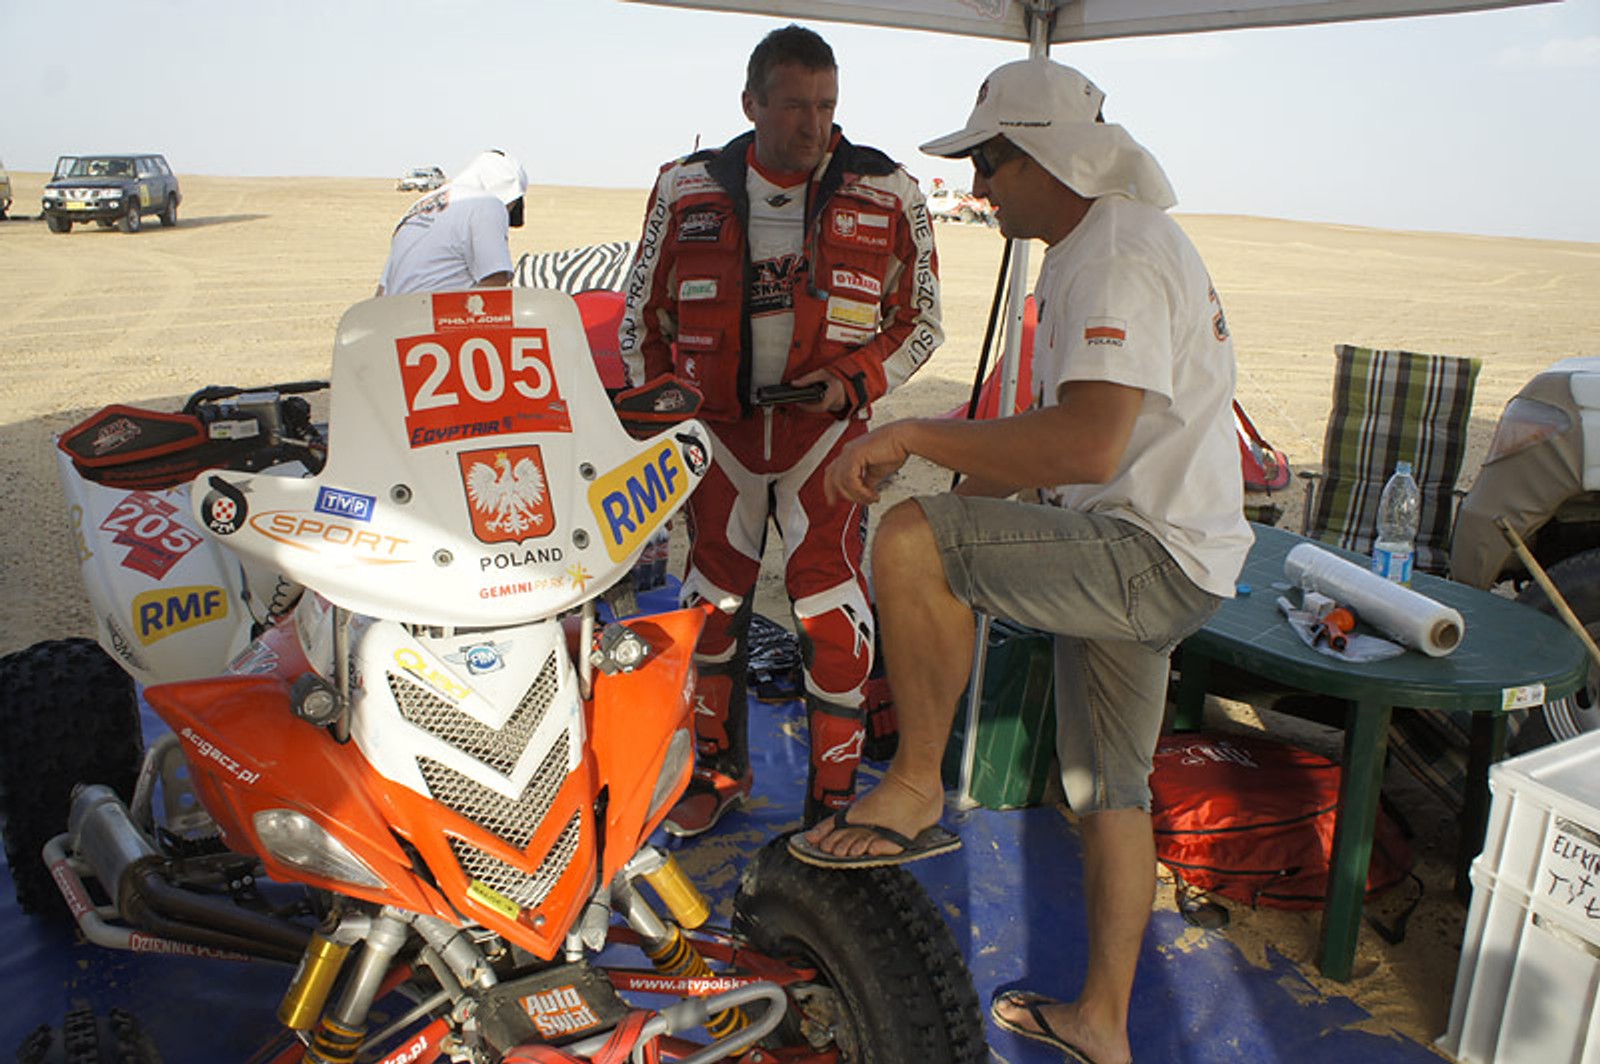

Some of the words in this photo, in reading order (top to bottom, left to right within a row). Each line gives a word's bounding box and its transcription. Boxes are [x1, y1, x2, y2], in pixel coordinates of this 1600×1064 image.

[912, 204, 930, 241] NIE
[404, 336, 552, 411] 205
[411, 420, 499, 445] EGYPTAIR
[325, 493, 366, 515] TVP
[602, 449, 680, 545] RMF
[103, 503, 200, 552] 205
[270, 514, 410, 555] SPORT
[480, 547, 563, 571] POLAND
[139, 590, 221, 636] RMF
[132, 933, 195, 956] DZIENNIK
[526, 987, 582, 1016] Auto
